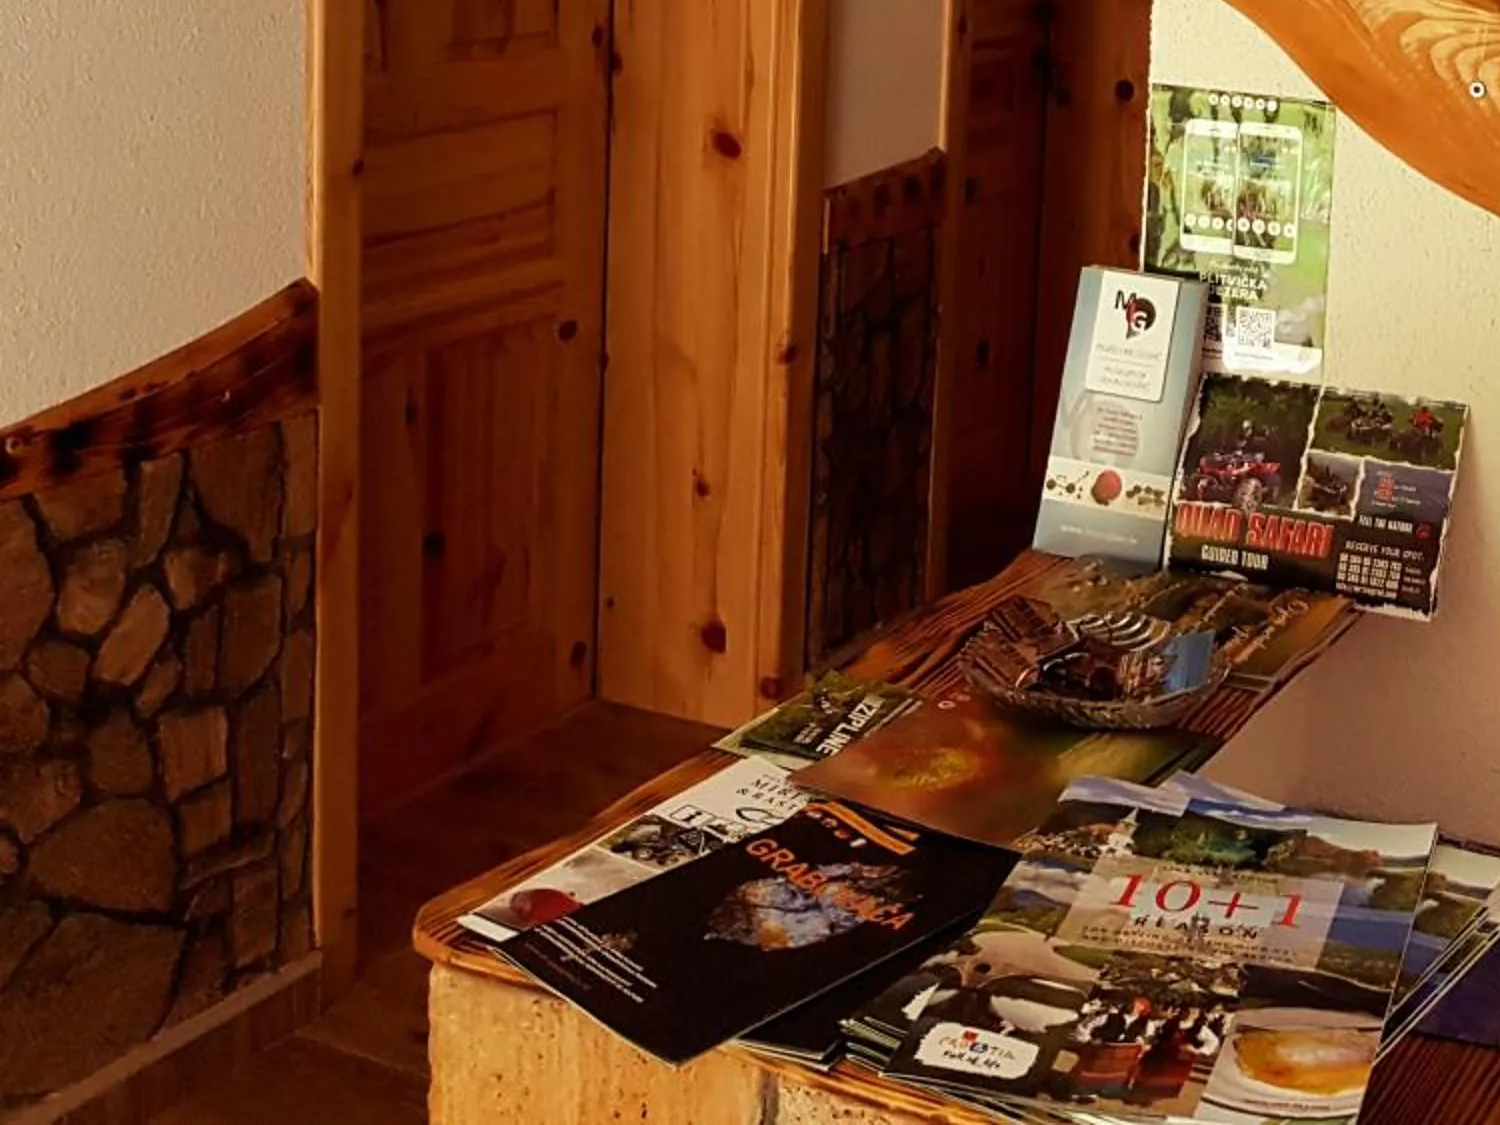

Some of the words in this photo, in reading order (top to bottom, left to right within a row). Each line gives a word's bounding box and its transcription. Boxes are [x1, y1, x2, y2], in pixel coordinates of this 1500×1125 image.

[1201, 544, 1239, 566] GUIDED
[1241, 551, 1270, 570] TOUR
[1246, 511, 1335, 559] SAFARI
[815, 702, 880, 757] ZIPLINE
[1109, 873, 1303, 928] 10+1
